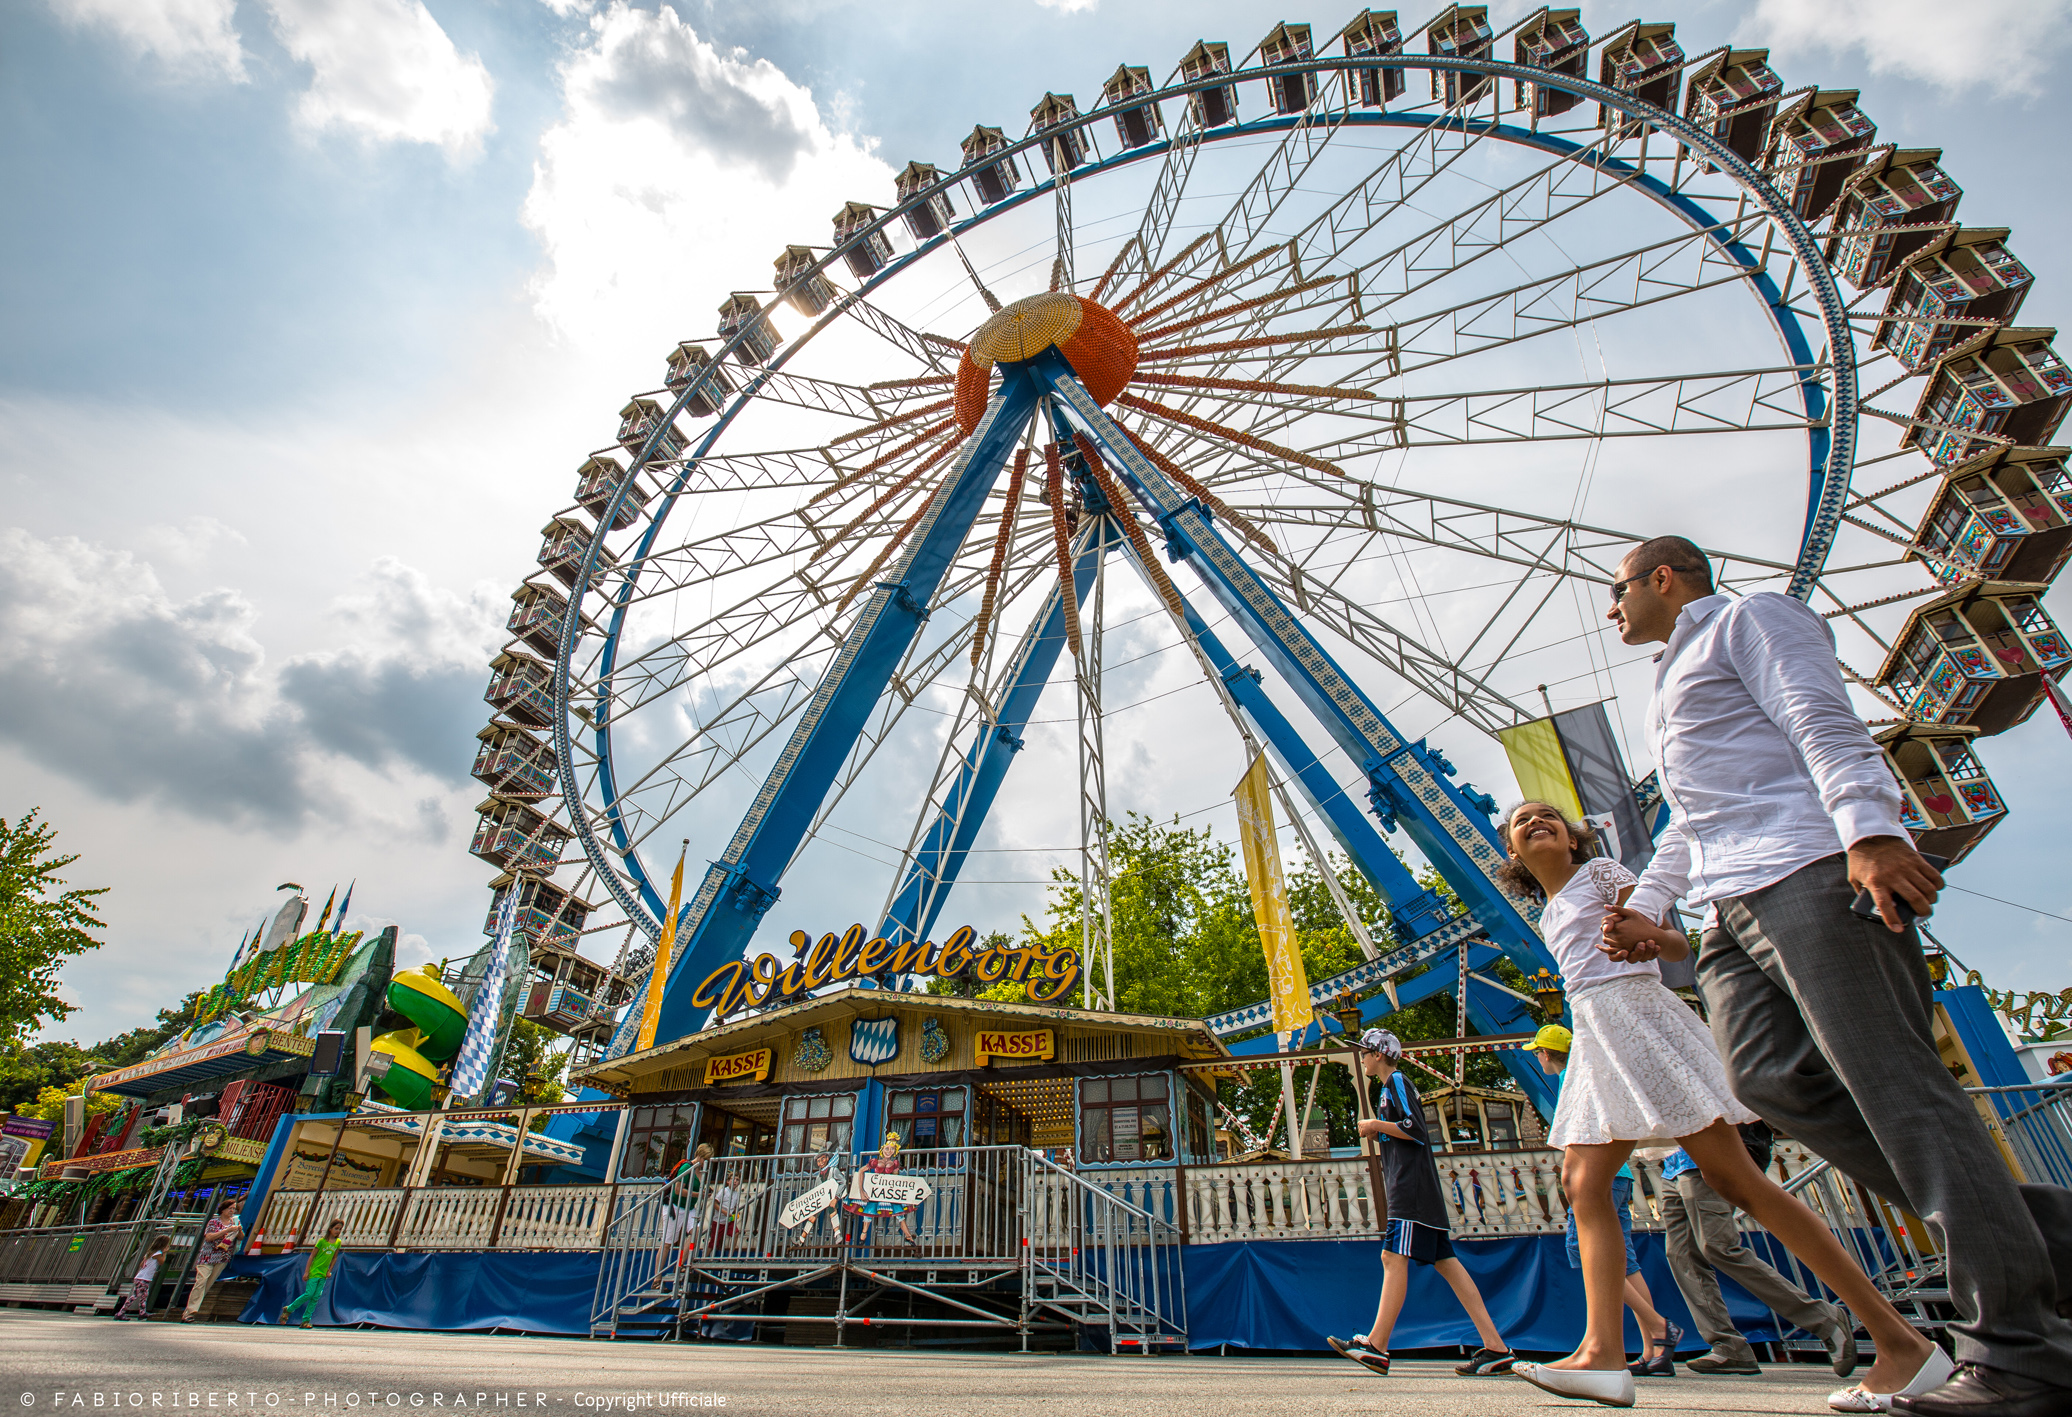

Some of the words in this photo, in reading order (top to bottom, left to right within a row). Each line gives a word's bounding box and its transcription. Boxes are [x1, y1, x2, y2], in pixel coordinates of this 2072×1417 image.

[692, 922, 1083, 1018] Willenborg
[271, 1034, 316, 1054] BENTEUE
[980, 1031, 1047, 1055] KASSE
[709, 1050, 765, 1077] KASSE
[870, 1187, 908, 1200] KASSE
[915, 1188, 924, 1200] 2
[871, 1174, 915, 1189] Eingang
[788, 1187, 826, 1212] Eingang
[792, 1199, 823, 1224] KASSE
[827, 1188, 833, 1201] 1
